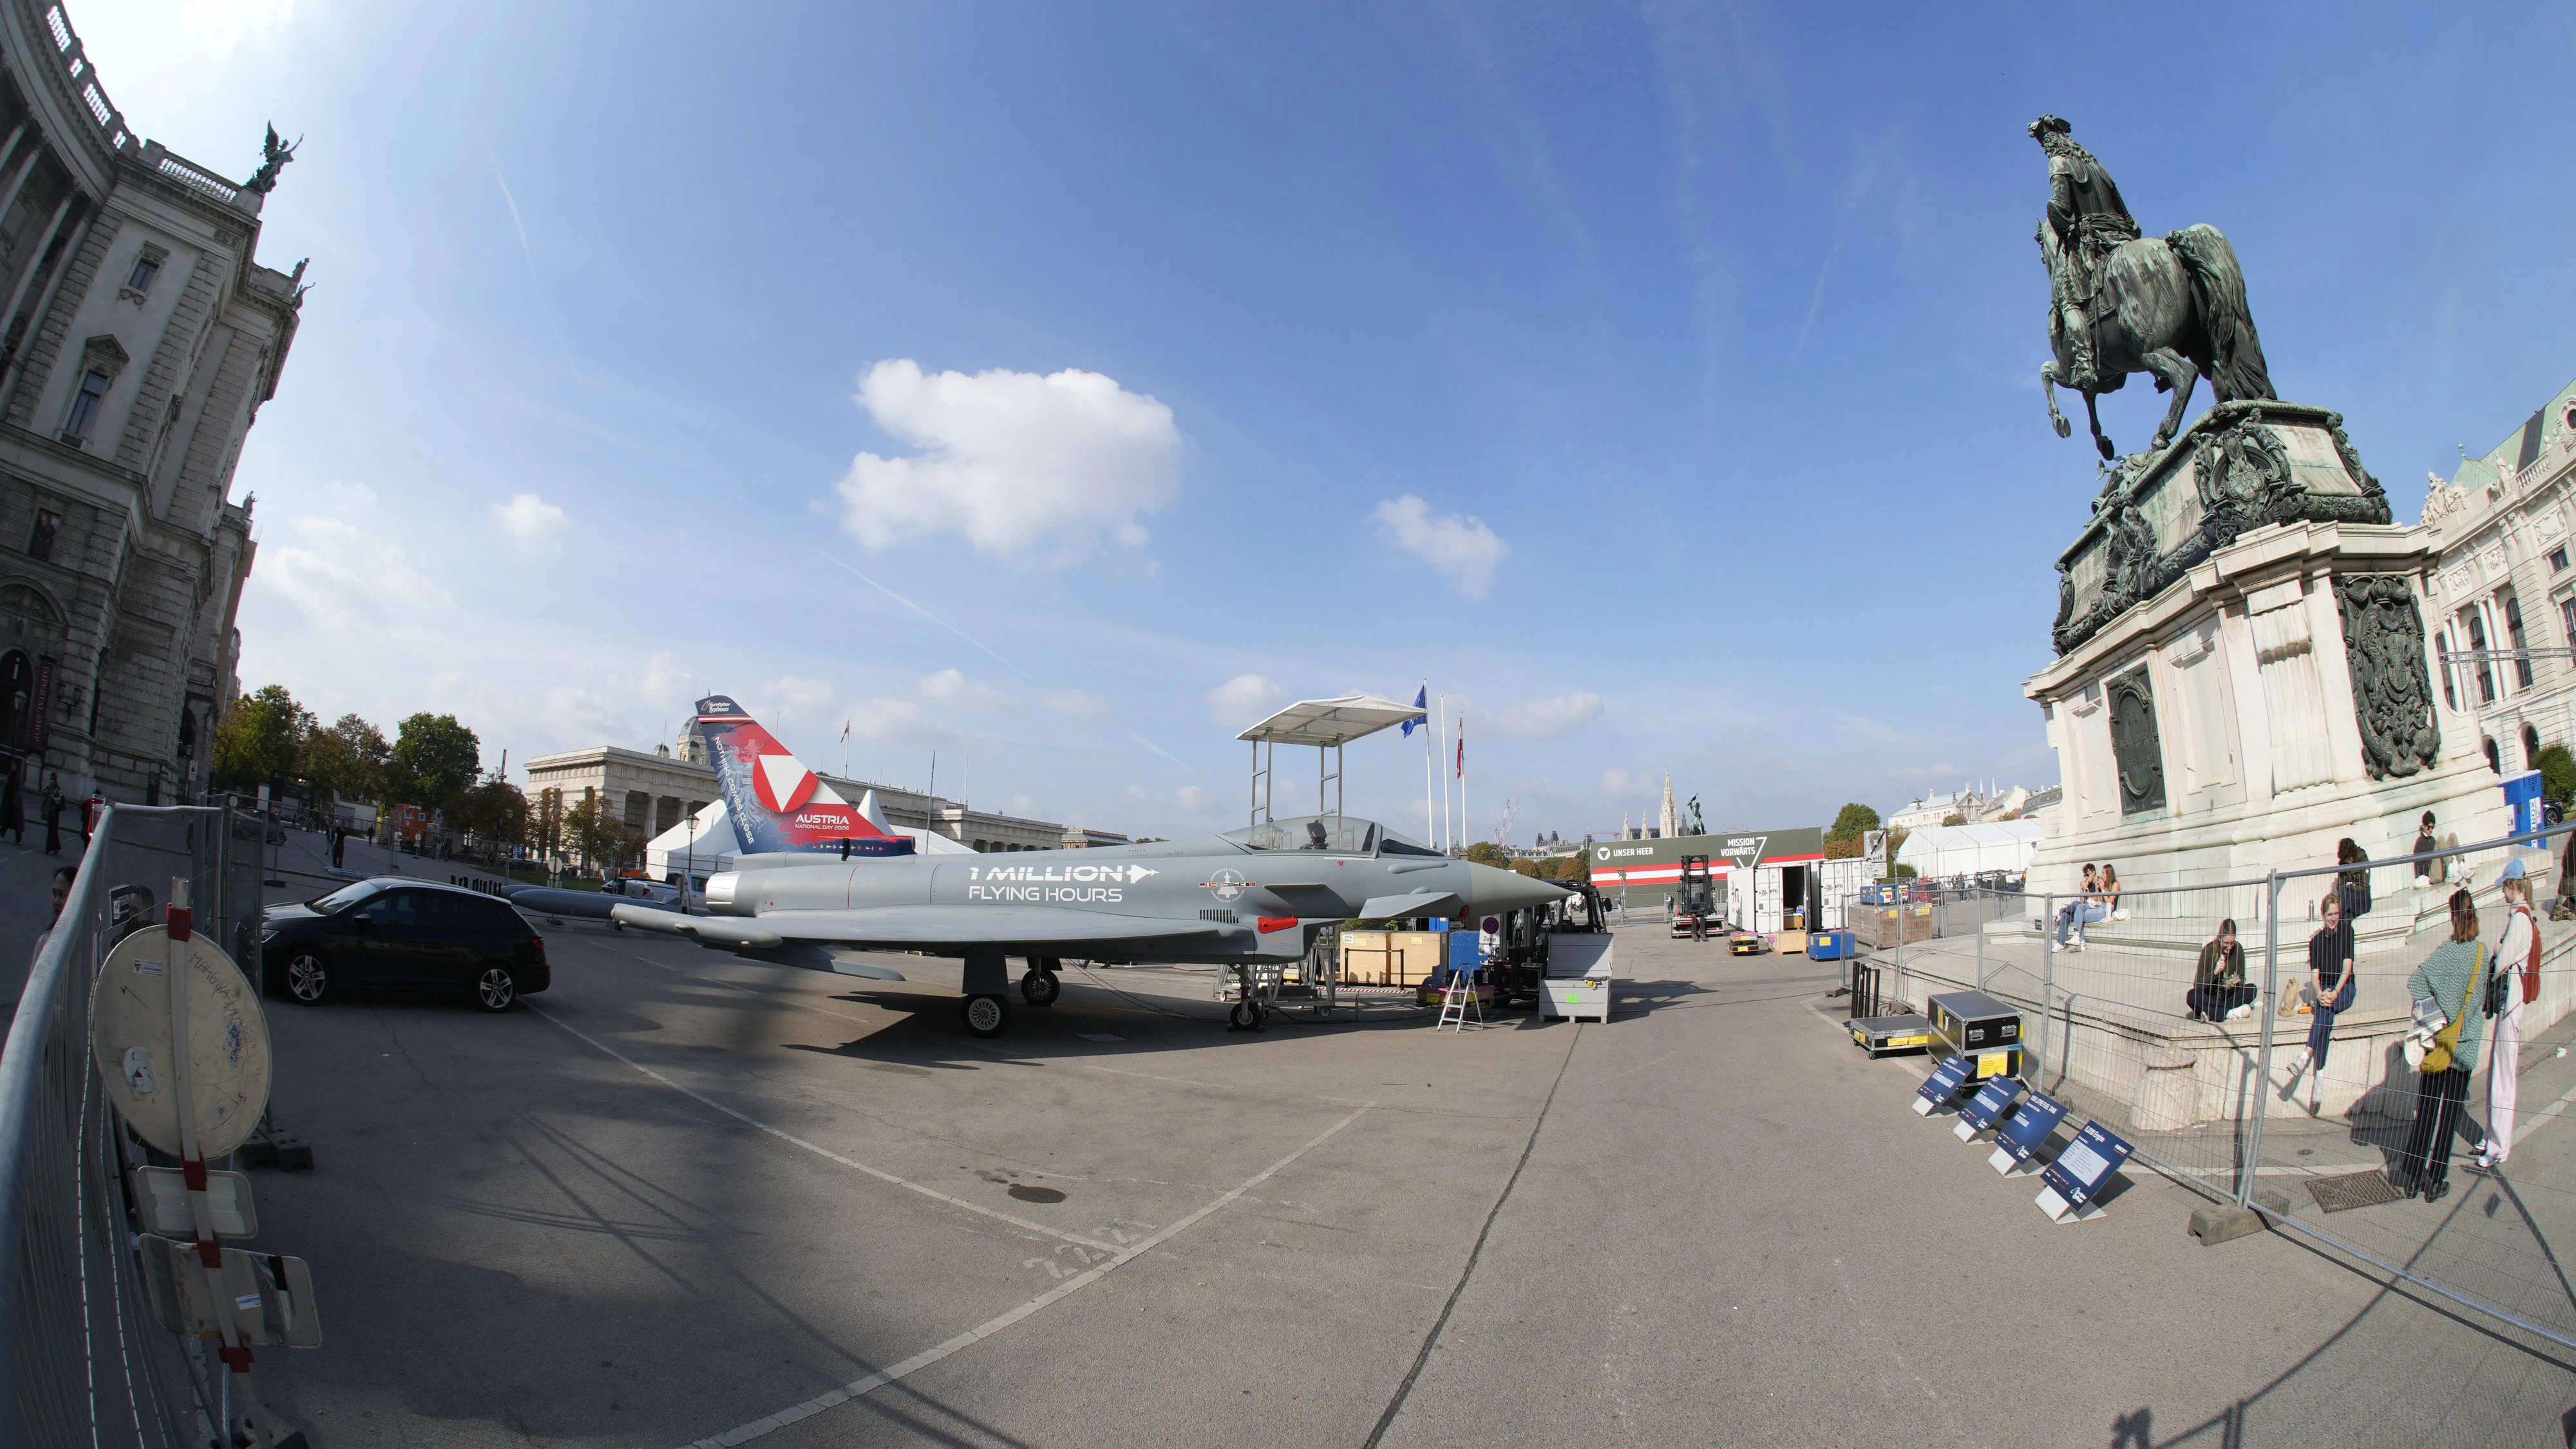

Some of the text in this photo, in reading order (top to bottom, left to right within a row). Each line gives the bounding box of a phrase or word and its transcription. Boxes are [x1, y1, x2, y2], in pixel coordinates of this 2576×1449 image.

[715, 736, 755, 845] NOTHING COMES CLOSE
[795, 814, 849, 824] AUSTRIA
[1727, 837, 1755, 848] MISSION
[1613, 847, 1654, 857] UNSER HEER
[1721, 846, 1756, 857] VORWÄRTS
[970, 866, 1123, 882] 1 MILLION
[969, 886, 1123, 902] FLYING HOURS
[2091, 1131, 2107, 1144] Engine
[1023, 1244, 1106, 1279] 22
